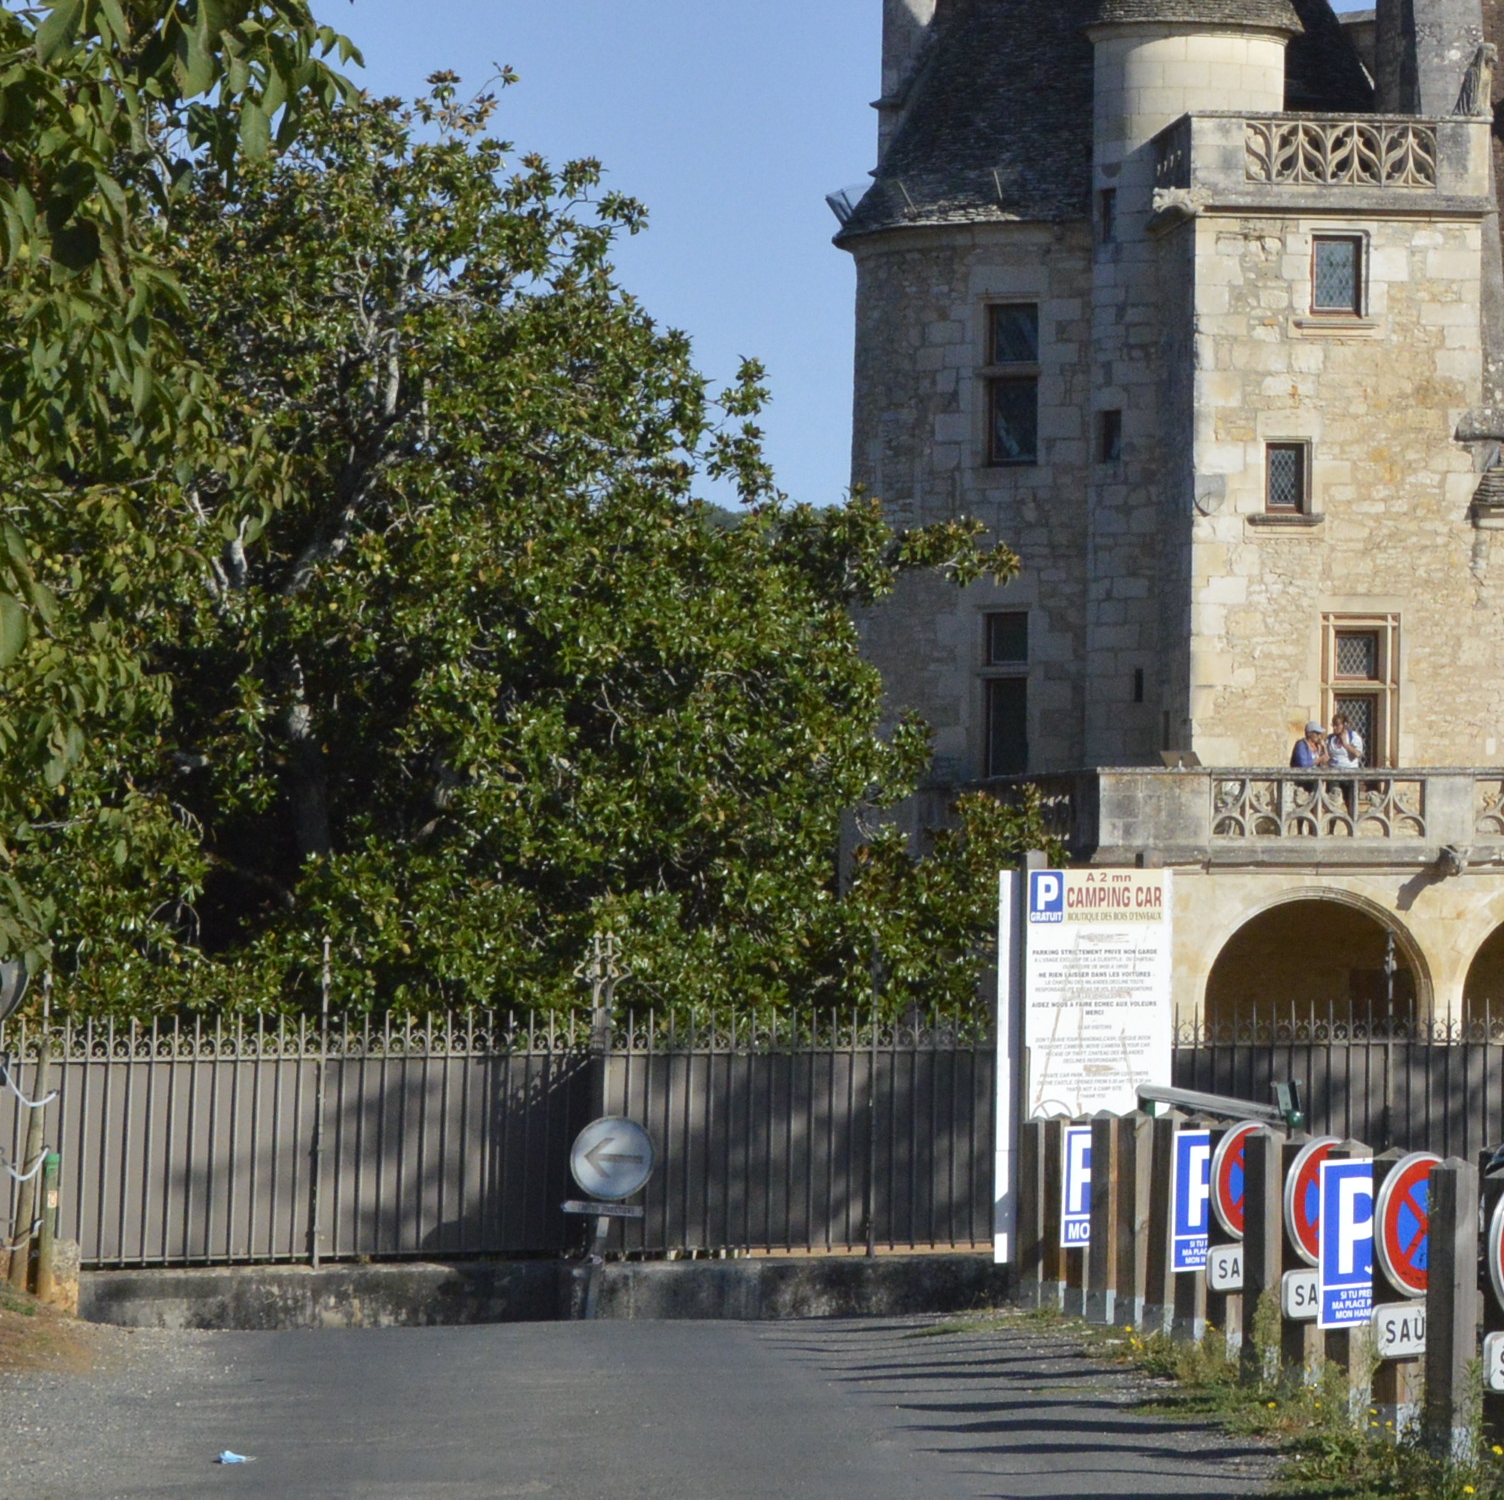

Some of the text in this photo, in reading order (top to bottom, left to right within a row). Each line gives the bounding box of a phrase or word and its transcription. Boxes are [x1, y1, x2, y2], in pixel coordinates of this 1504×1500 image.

[1099, 872, 1107, 882] 2
[1111, 874, 1132, 882] mn
[1036, 875, 1059, 911] P
[1066, 886, 1162, 908] CAMPING CAR
[1030, 911, 1063, 922] GRATUIT
[1067, 911, 1099, 923] BOUTIQUE
[1100, 911, 1113, 921] DES
[1113, 911, 1128, 921] BOIS
[1067, 1222, 1089, 1240] MO
[1338, 1176, 1373, 1274] P
[1182, 1247, 1208, 1257] MA PLAC
[1185, 1256, 1200, 1265] MON
[1218, 1257, 1240, 1279] SA
[1295, 1282, 1318, 1306] SA
[1340, 1288, 1372, 1300] SI TU PRE
[1332, 1301, 1345, 1310] MA
[1345, 1299, 1366, 1308] PLACE
[1335, 1310, 1353, 1320] MON
[1385, 1317, 1425, 1345] SAU
